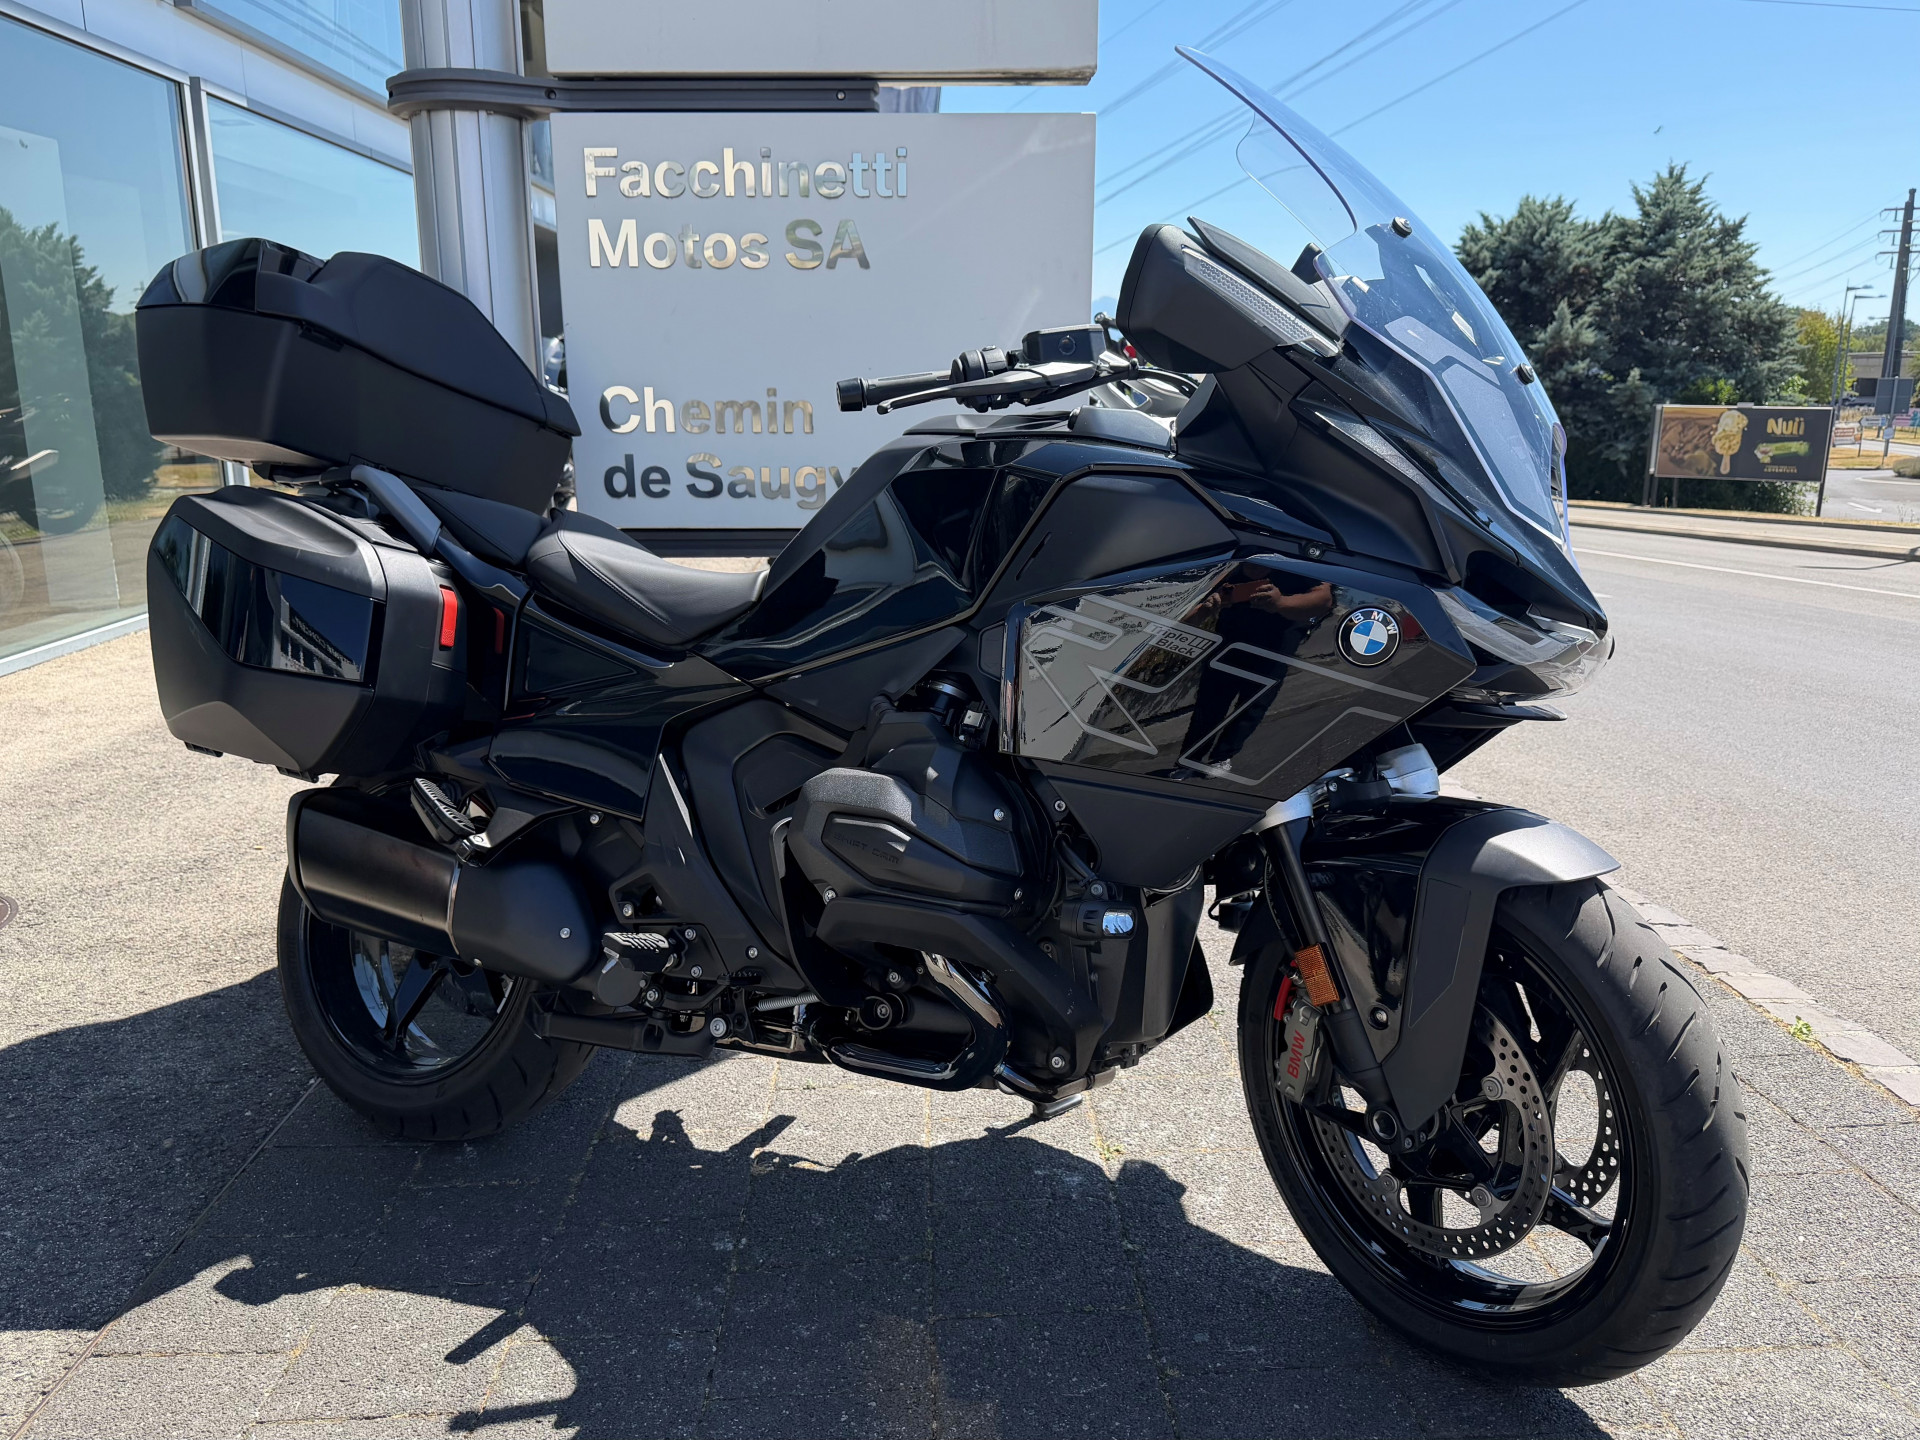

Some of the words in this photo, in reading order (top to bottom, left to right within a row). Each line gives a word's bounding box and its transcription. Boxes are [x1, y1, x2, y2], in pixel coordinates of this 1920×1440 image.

[583, 147, 908, 198] Facchinetti
[587, 219, 770, 270] Motos
[785, 219, 870, 270] SA
[600, 385, 814, 434] Chemin
[604, 453, 671, 499] de
[1151, 624, 1188, 643] Triple
[1351, 610, 1398, 635] BMW
[1155, 637, 1196, 657] Black
[1287, 1030, 1306, 1079] BMW
